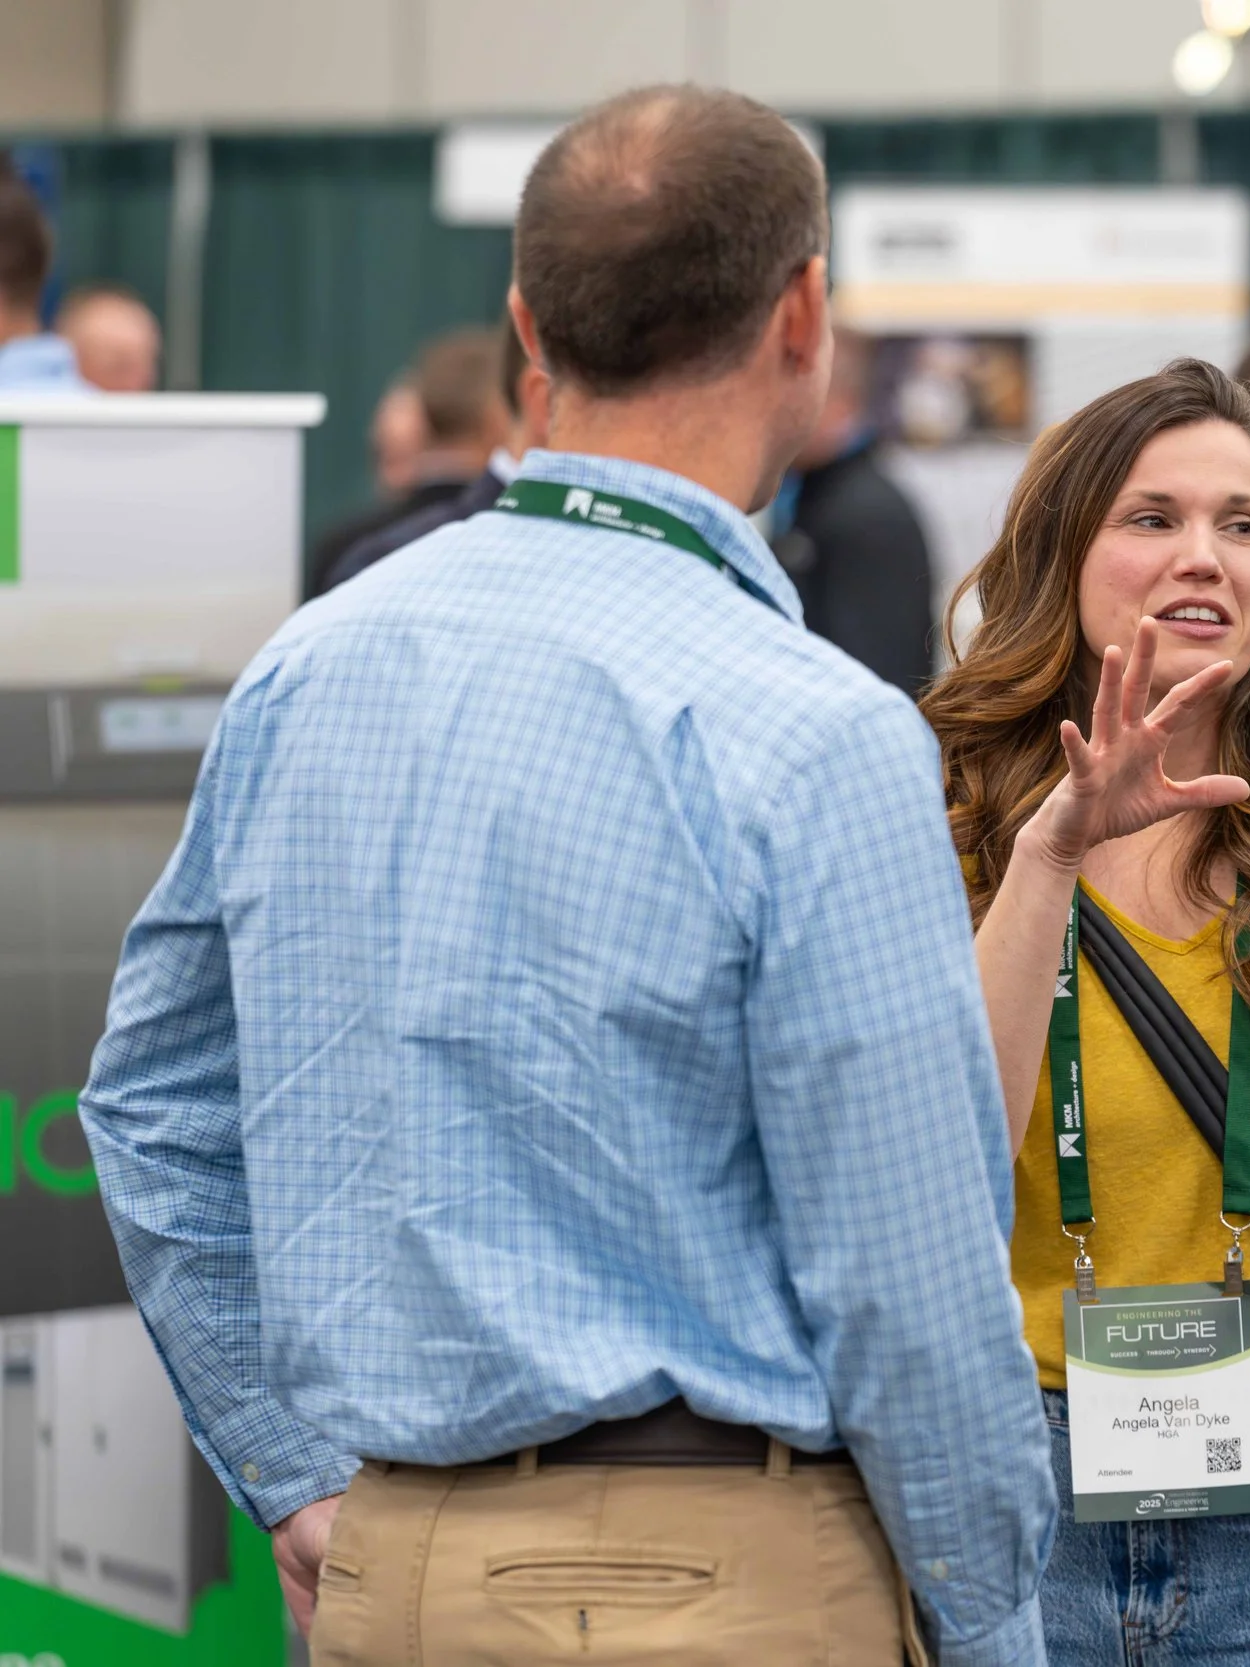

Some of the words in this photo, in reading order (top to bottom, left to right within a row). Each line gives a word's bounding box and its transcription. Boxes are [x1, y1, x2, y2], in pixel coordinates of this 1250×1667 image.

[1070, 1061, 1079, 1082] design
[1063, 1104, 1073, 1128] MKM
[1073, 1089, 1081, 1128] architecture
[1116, 1310, 1181, 1320] ENGINEERING
[1184, 1308, 1202, 1317] THE
[1106, 1320, 1217, 1343] FUTURE
[1110, 1350, 1138, 1358] SUCCESS
[1146, 1348, 1175, 1356] THROUGH
[1139, 1395, 1200, 1415] Angela
[1112, 1416, 1159, 1432] Angela
[1164, 1415, 1191, 1428] Van
[1195, 1413, 1230, 1430] Dyke
[1157, 1430, 1179, 1439] HGA
[1097, 1468, 1133, 1477] Attendee
[1139, 1499, 1161, 1508] 2025
[1165, 1497, 1209, 1508] Engineering
